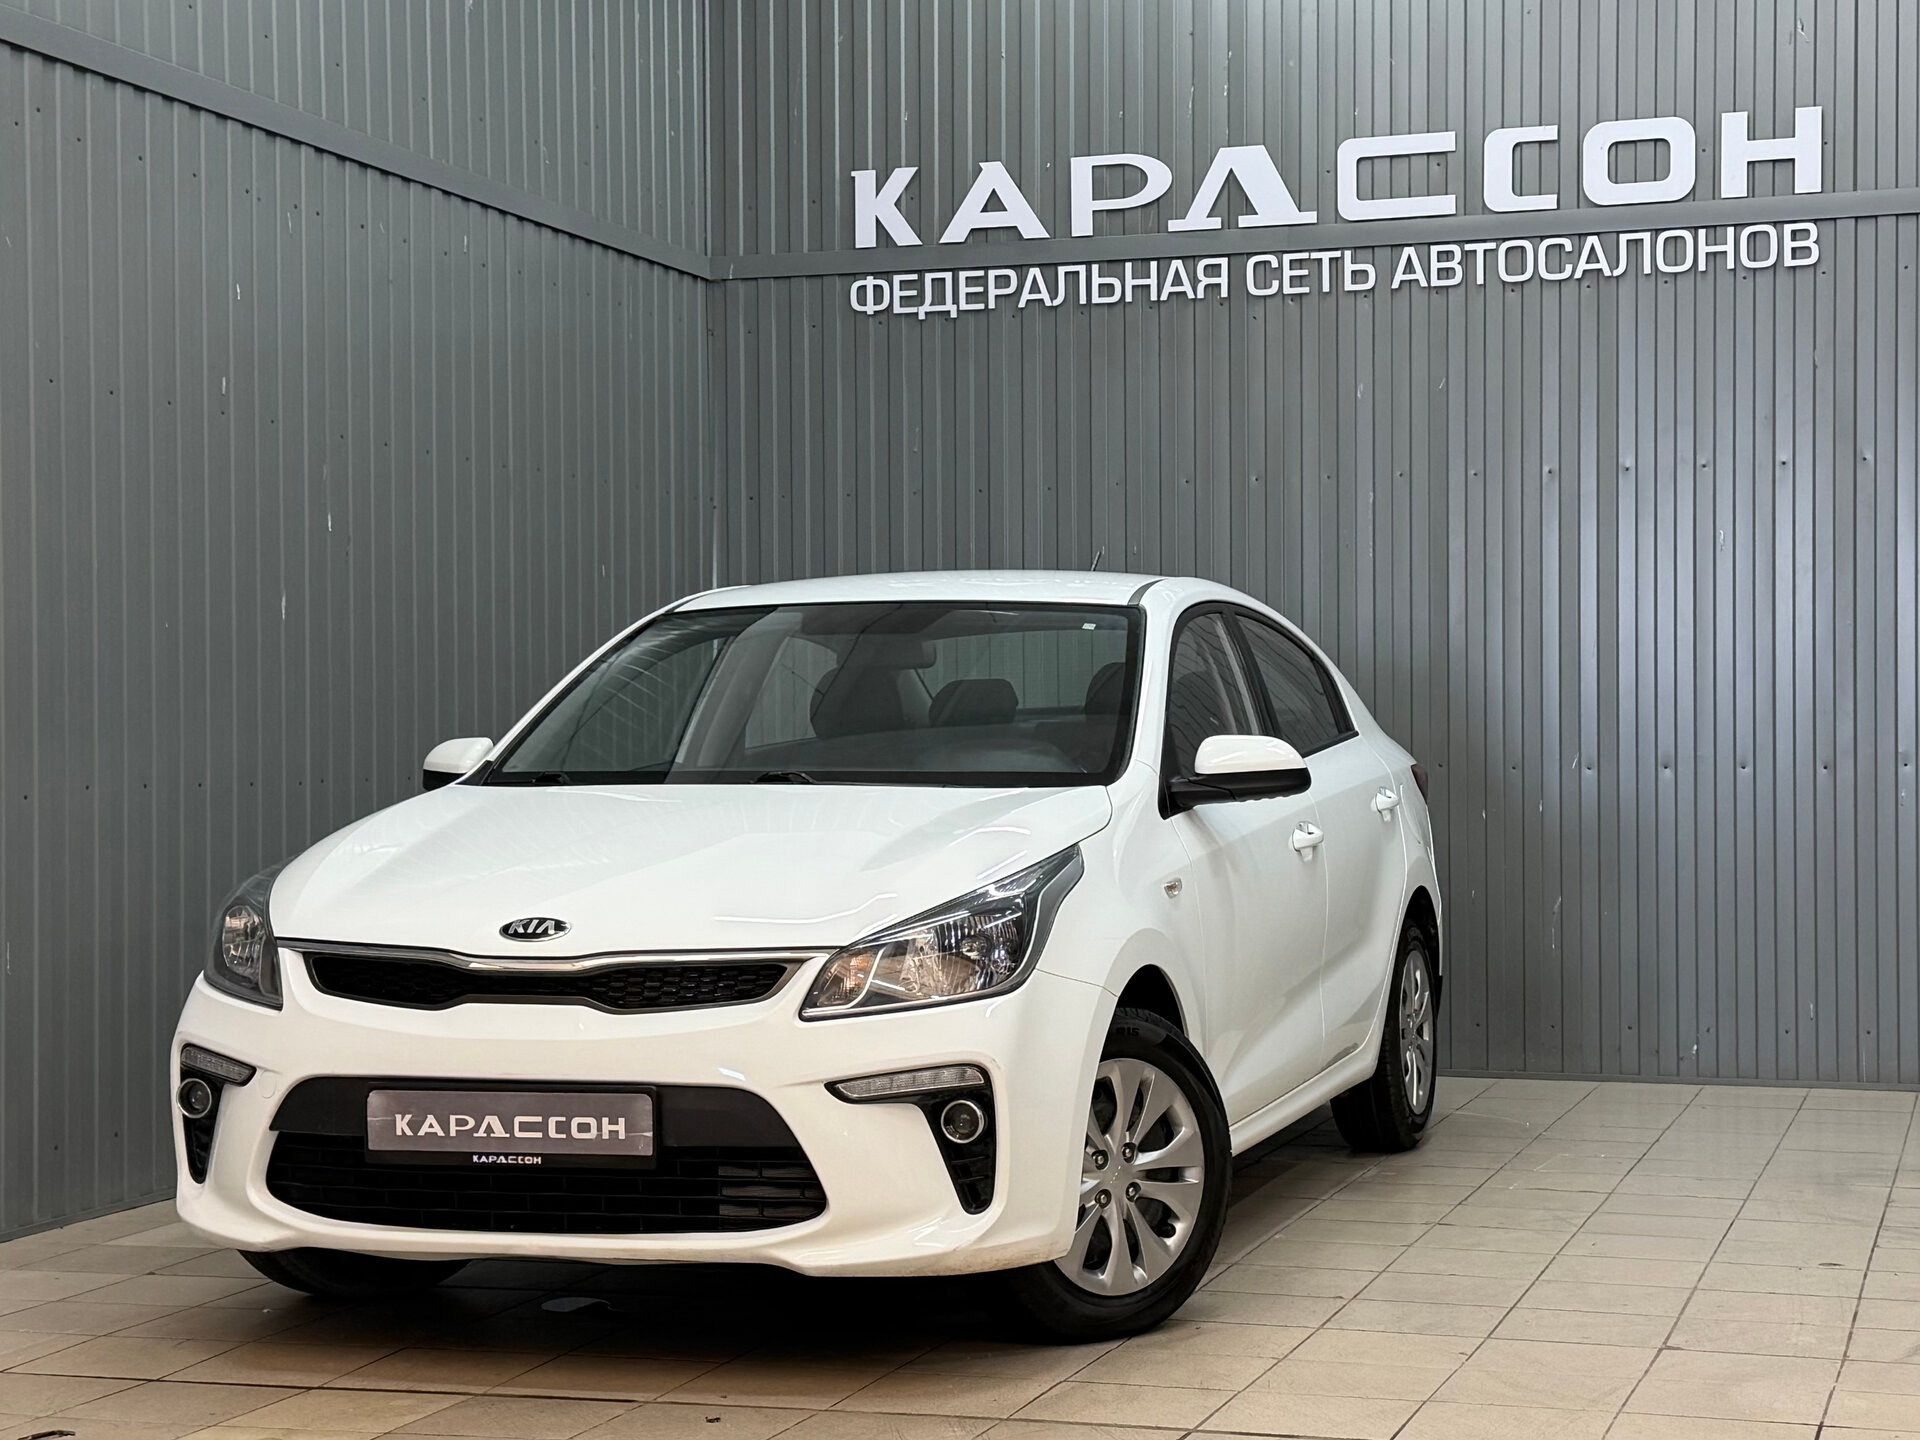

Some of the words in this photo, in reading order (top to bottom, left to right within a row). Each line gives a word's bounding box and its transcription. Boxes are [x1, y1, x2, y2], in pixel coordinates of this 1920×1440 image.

[849, 256, 1229, 320] ФЕДЕРАЛЬНАЯ
[1245, 249, 1376, 297] СЕТЬ
[1391, 221, 1821, 290] АВТОСАЛОНОВ
[507, 919, 556, 935] KIA
